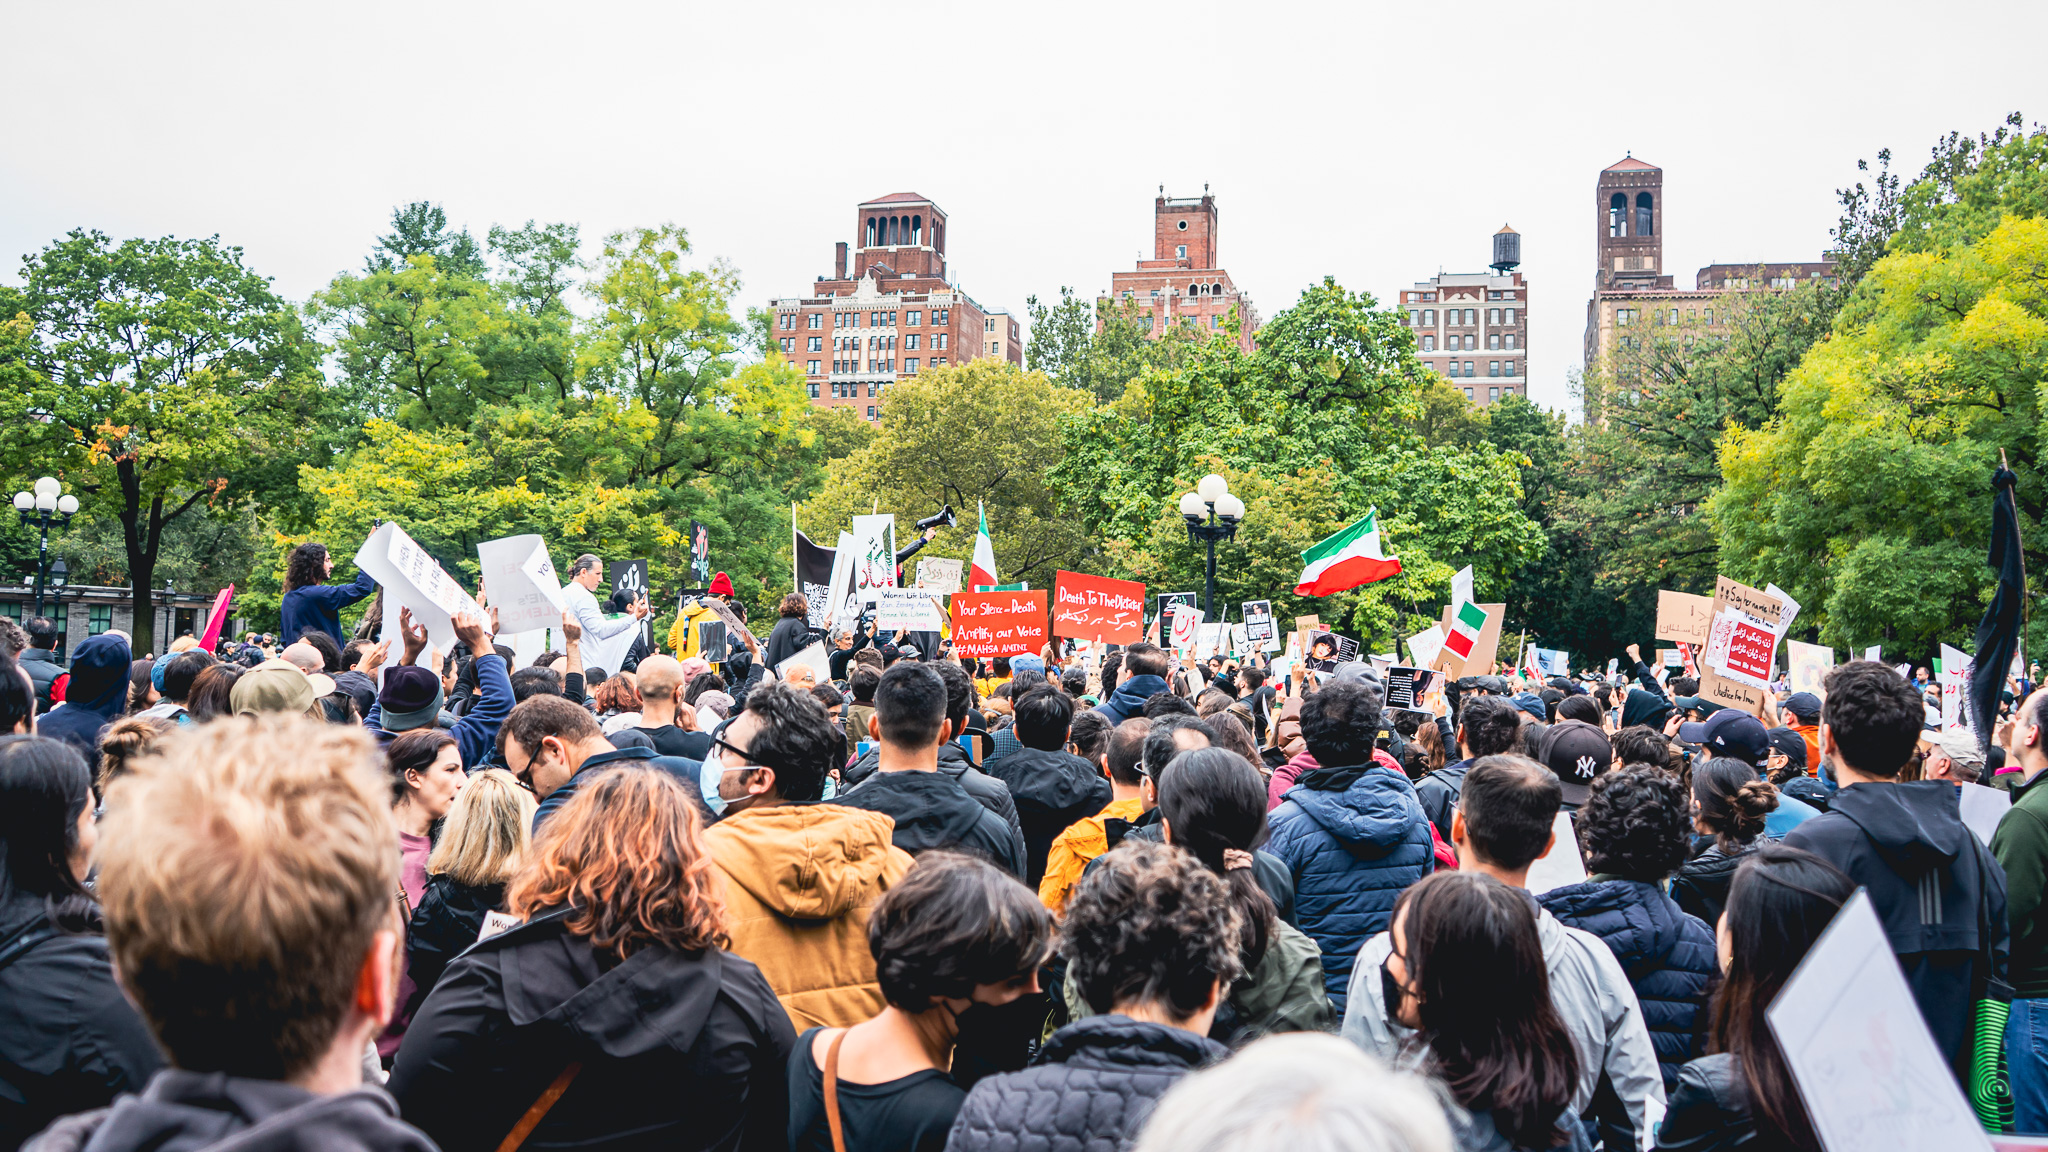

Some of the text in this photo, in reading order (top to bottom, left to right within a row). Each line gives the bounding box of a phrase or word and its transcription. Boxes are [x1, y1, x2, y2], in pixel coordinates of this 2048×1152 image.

[1059, 585, 1086, 606] Death
[1085, 589, 1098, 606] To
[957, 599, 978, 617] Your
[1011, 598, 1037, 614] Death
[1089, 616, 1104, 626] بر
[1174, 614, 1196, 643] زن
[996, 628, 1013, 639] our
[1016, 624, 1042, 638] Voice
[1000, 643, 1028, 654] AMINI
